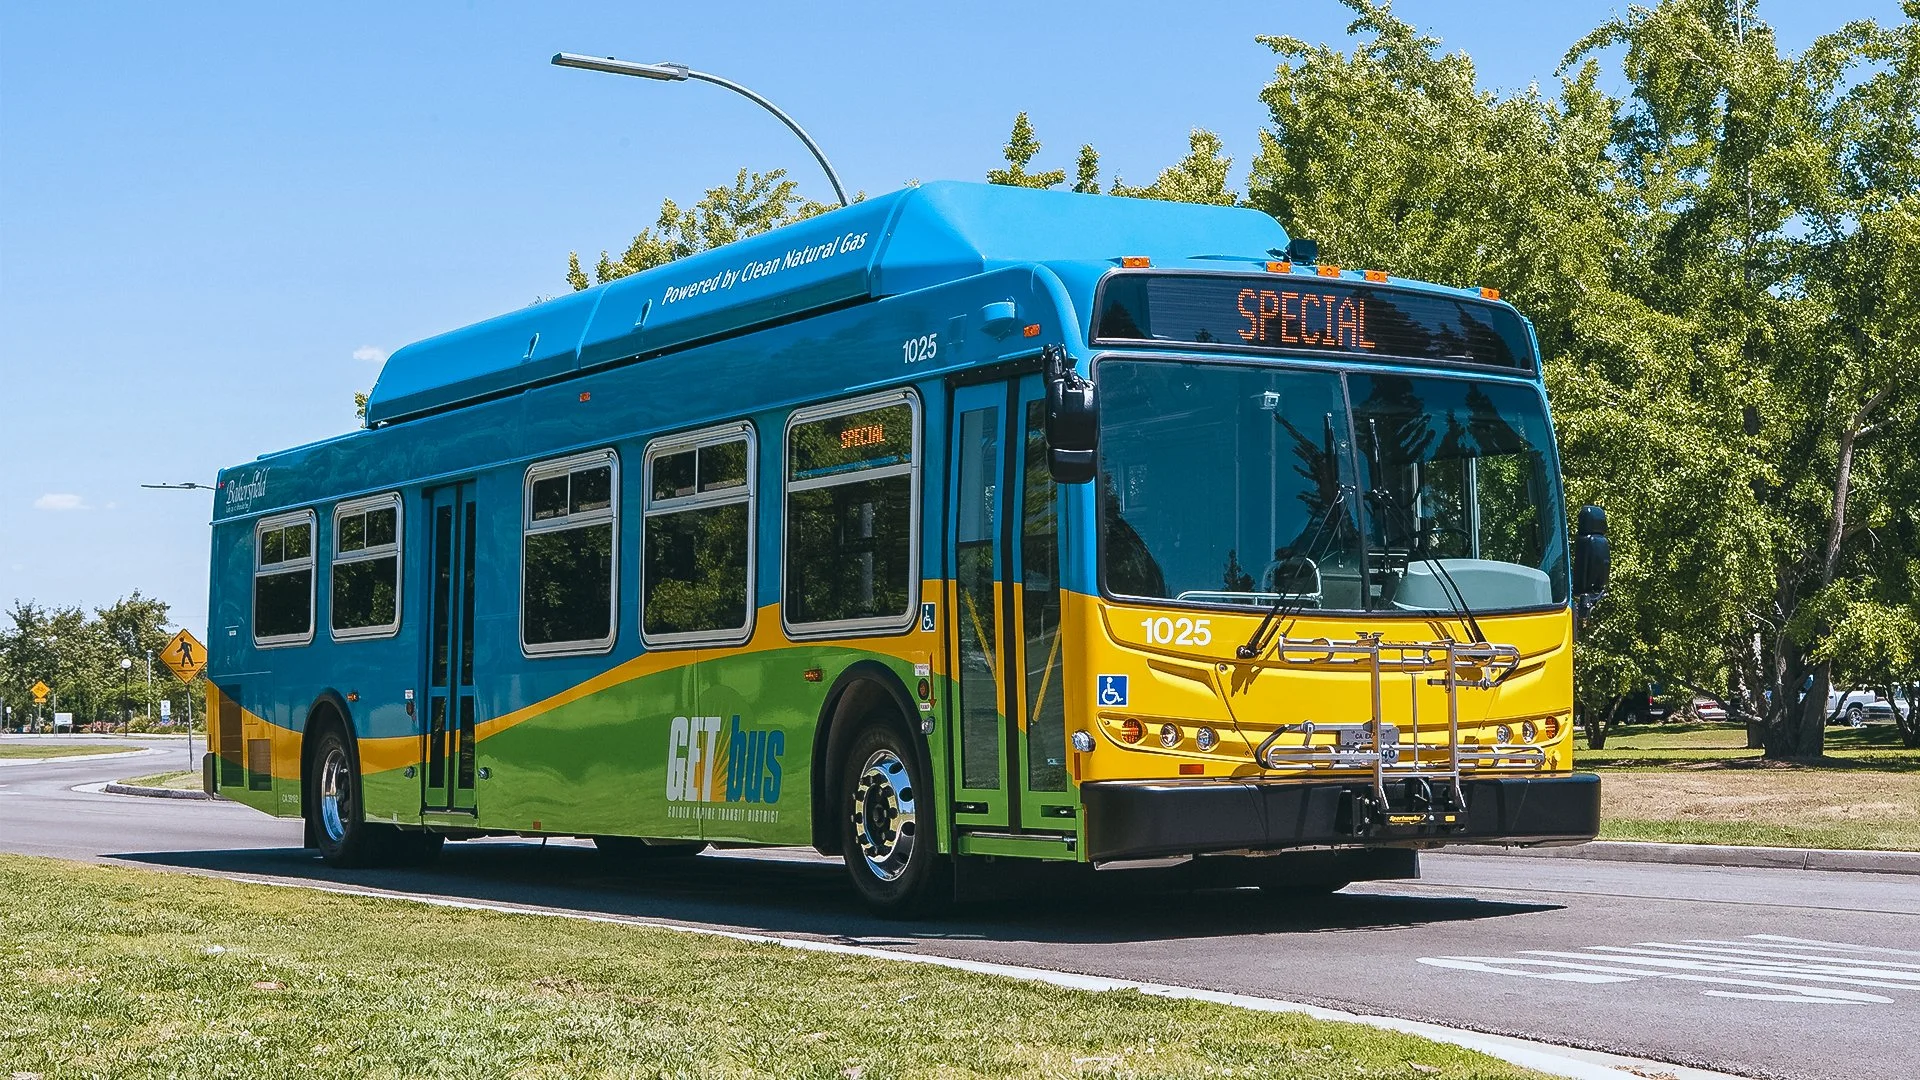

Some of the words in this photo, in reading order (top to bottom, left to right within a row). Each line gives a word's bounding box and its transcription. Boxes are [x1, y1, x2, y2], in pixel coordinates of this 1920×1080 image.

[661, 272, 722, 305] Powered
[721, 269, 740, 290] by
[741, 258, 780, 283] Clean
[781, 237, 841, 271] Natural
[840, 232, 868, 254] Gas
[1237, 288, 1376, 348] SPECIAL
[903, 333, 937, 364] 1025
[841, 424, 885, 448] SPECIAL
[226, 467, 270, 512] Bakersfield
[1141, 617, 1212, 646] 1025
[666, 716, 721, 801] GET
[726, 715, 785, 804] bus
[668, 806, 690, 818] GOLDEN
[692, 807, 715, 819] EMPIRE
[718, 808, 745, 821] TRANSIT
[747, 810, 779, 823] DISTRICT
